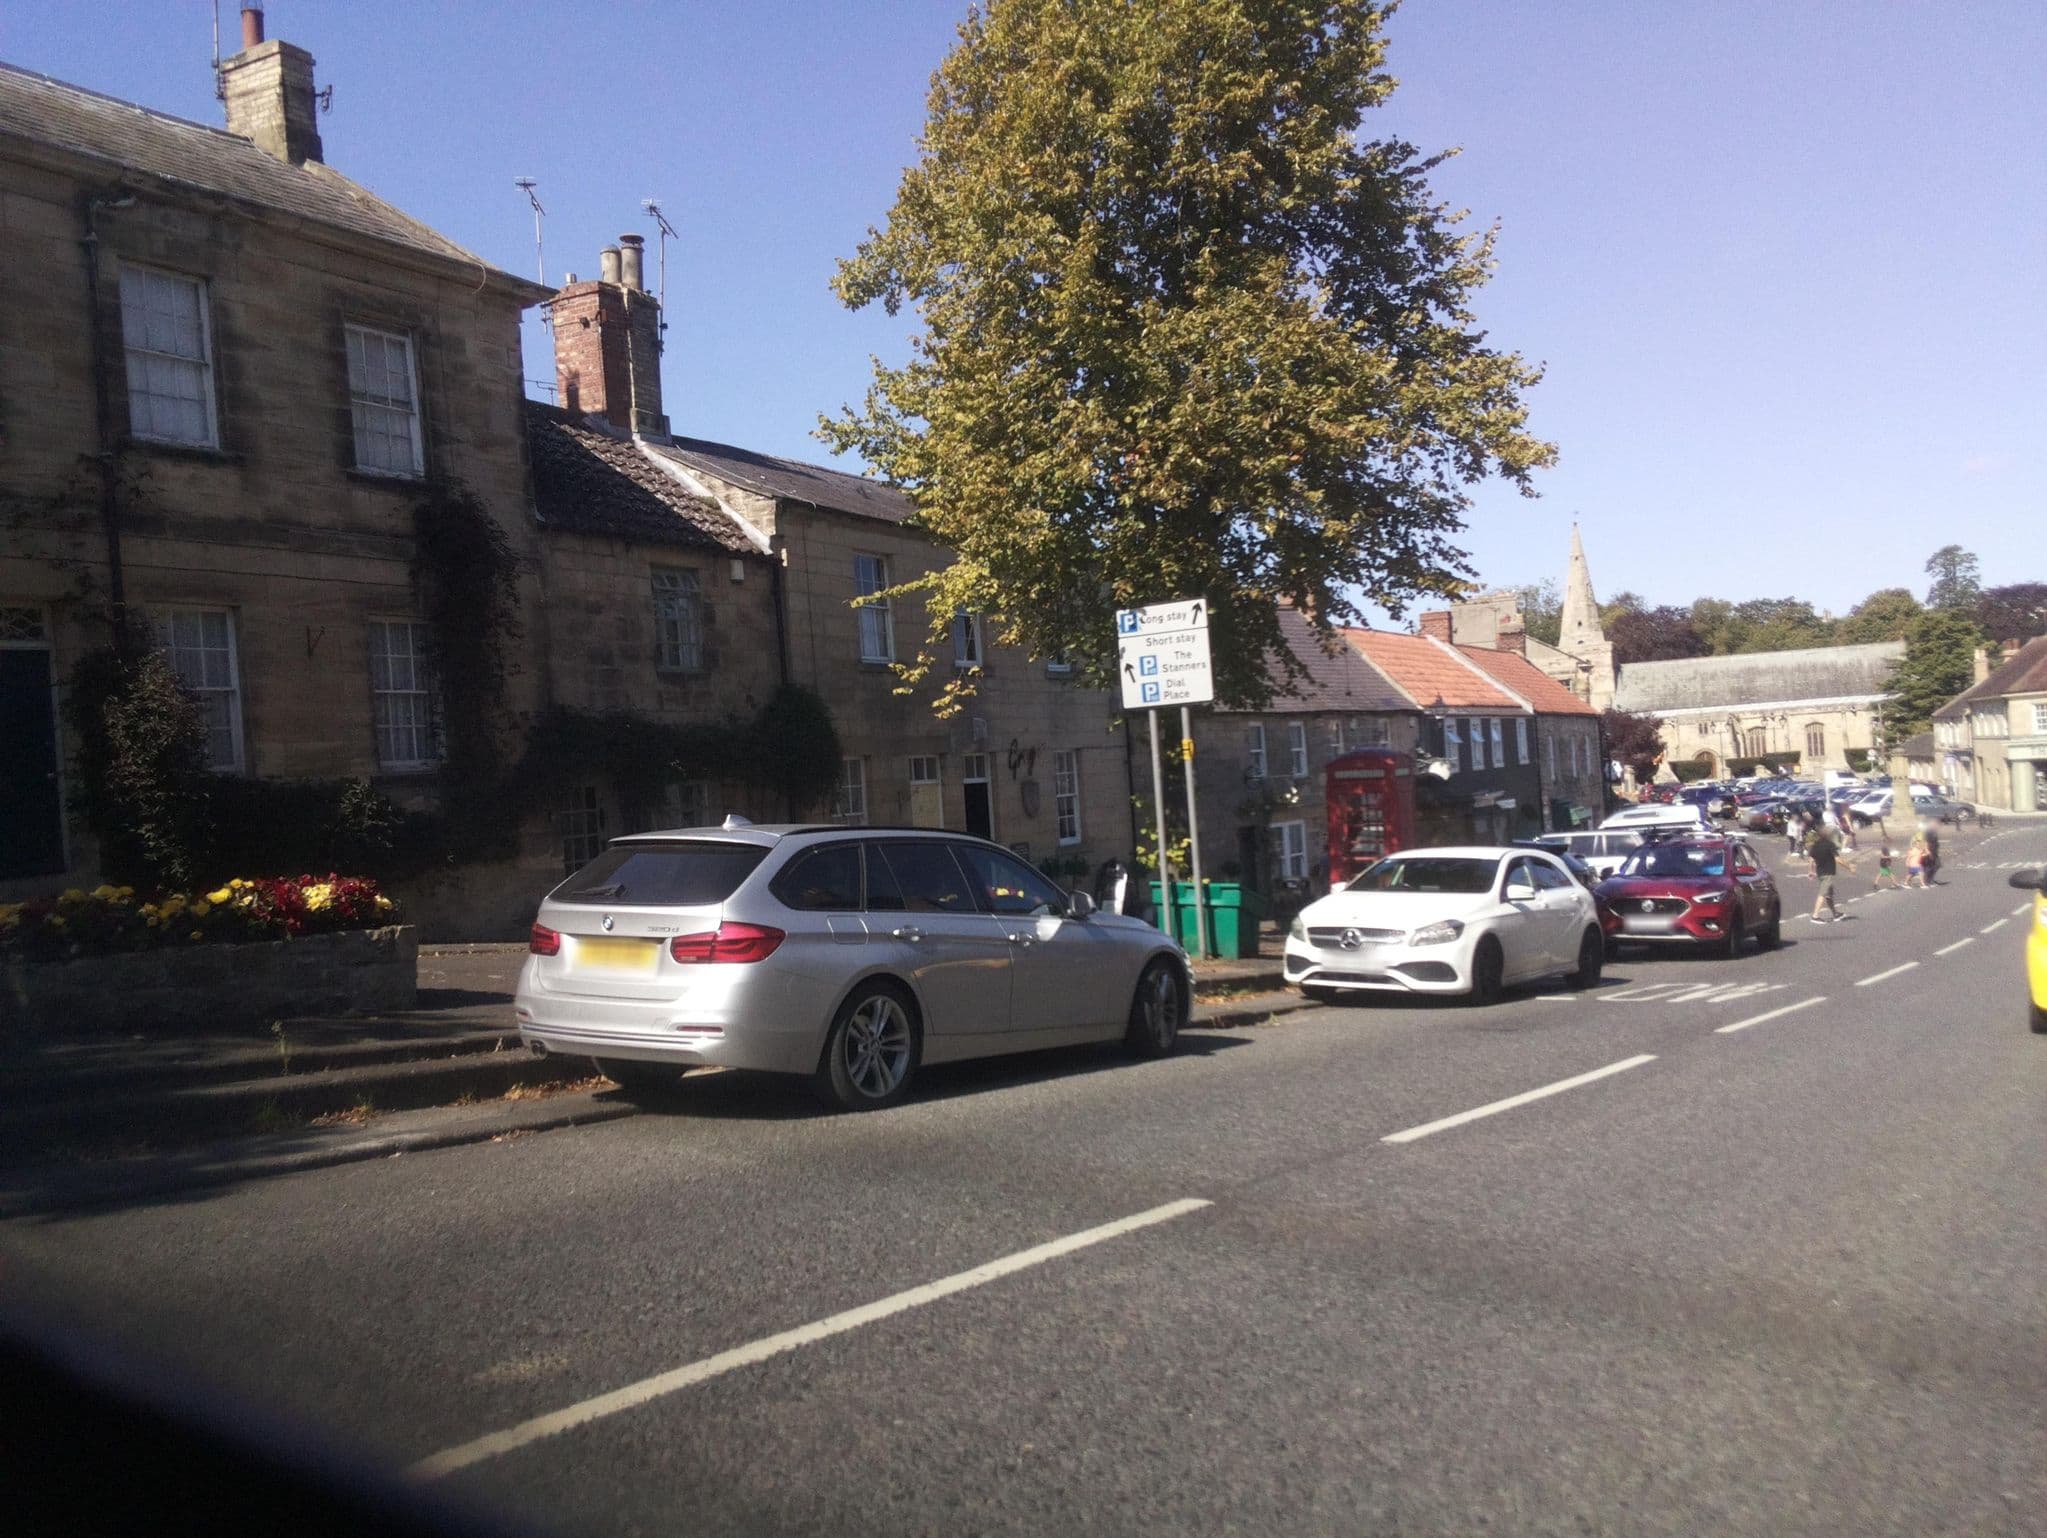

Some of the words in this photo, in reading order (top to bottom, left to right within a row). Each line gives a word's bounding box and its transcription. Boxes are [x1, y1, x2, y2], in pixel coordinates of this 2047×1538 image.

[1167, 612, 1186, 622] stay
[1146, 636, 1173, 647] Short
[1176, 634, 1196, 644] stay
[1174, 651, 1192, 659] The
[1143, 658, 1155, 674] P
[1162, 661, 1206, 673] Stanners
[1166, 679, 1185, 688] Dial
[1145, 684, 1157, 701] P
[1164, 689, 1190, 700] Place
